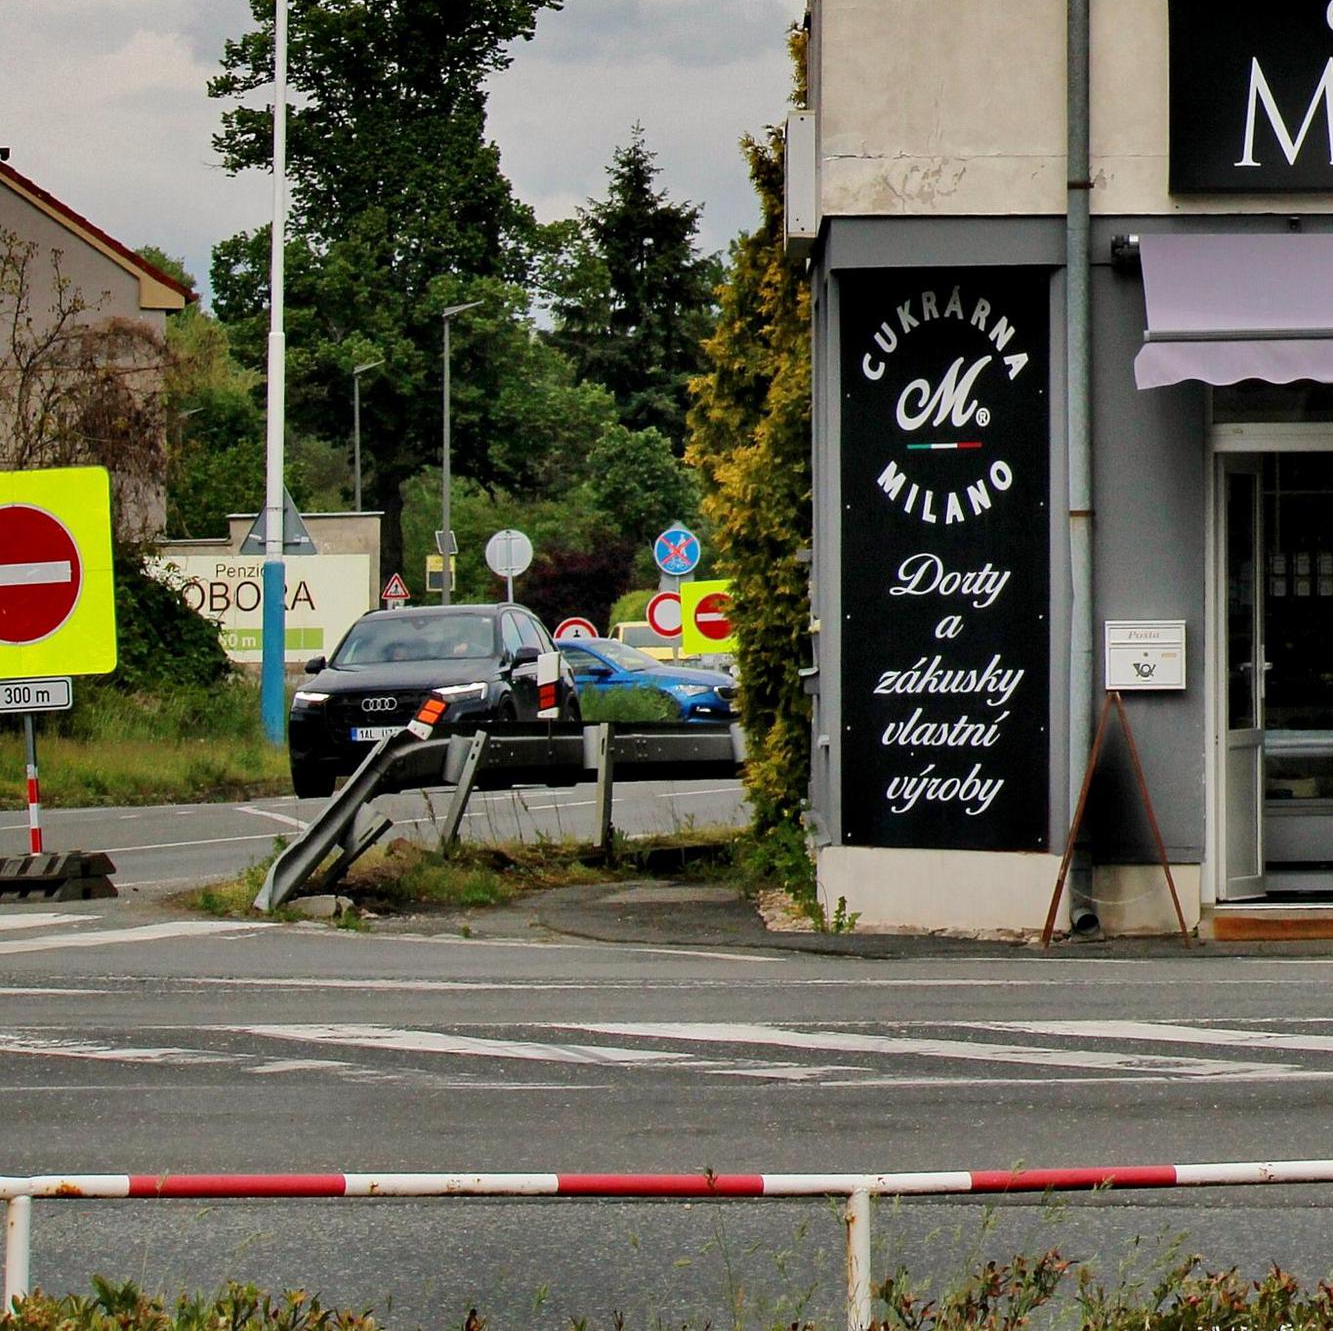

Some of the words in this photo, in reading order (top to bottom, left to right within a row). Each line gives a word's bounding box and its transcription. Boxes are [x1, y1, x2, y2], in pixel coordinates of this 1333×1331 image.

[862, 285, 1029, 381] CUKRÁRNA
[877, 460, 1013, 524] MILANO
[181, 580, 316, 612] OBOA
[889, 553, 1011, 608] Dorty
[241, 635, 257, 647] m
[934, 615, 964, 639] a
[4, 687, 31, 704] 300
[36, 689, 50, 702] m
[873, 654, 1024, 706] zákusky
[882, 707, 1010, 747] vlastní
[886, 763, 1004, 815] výroby
